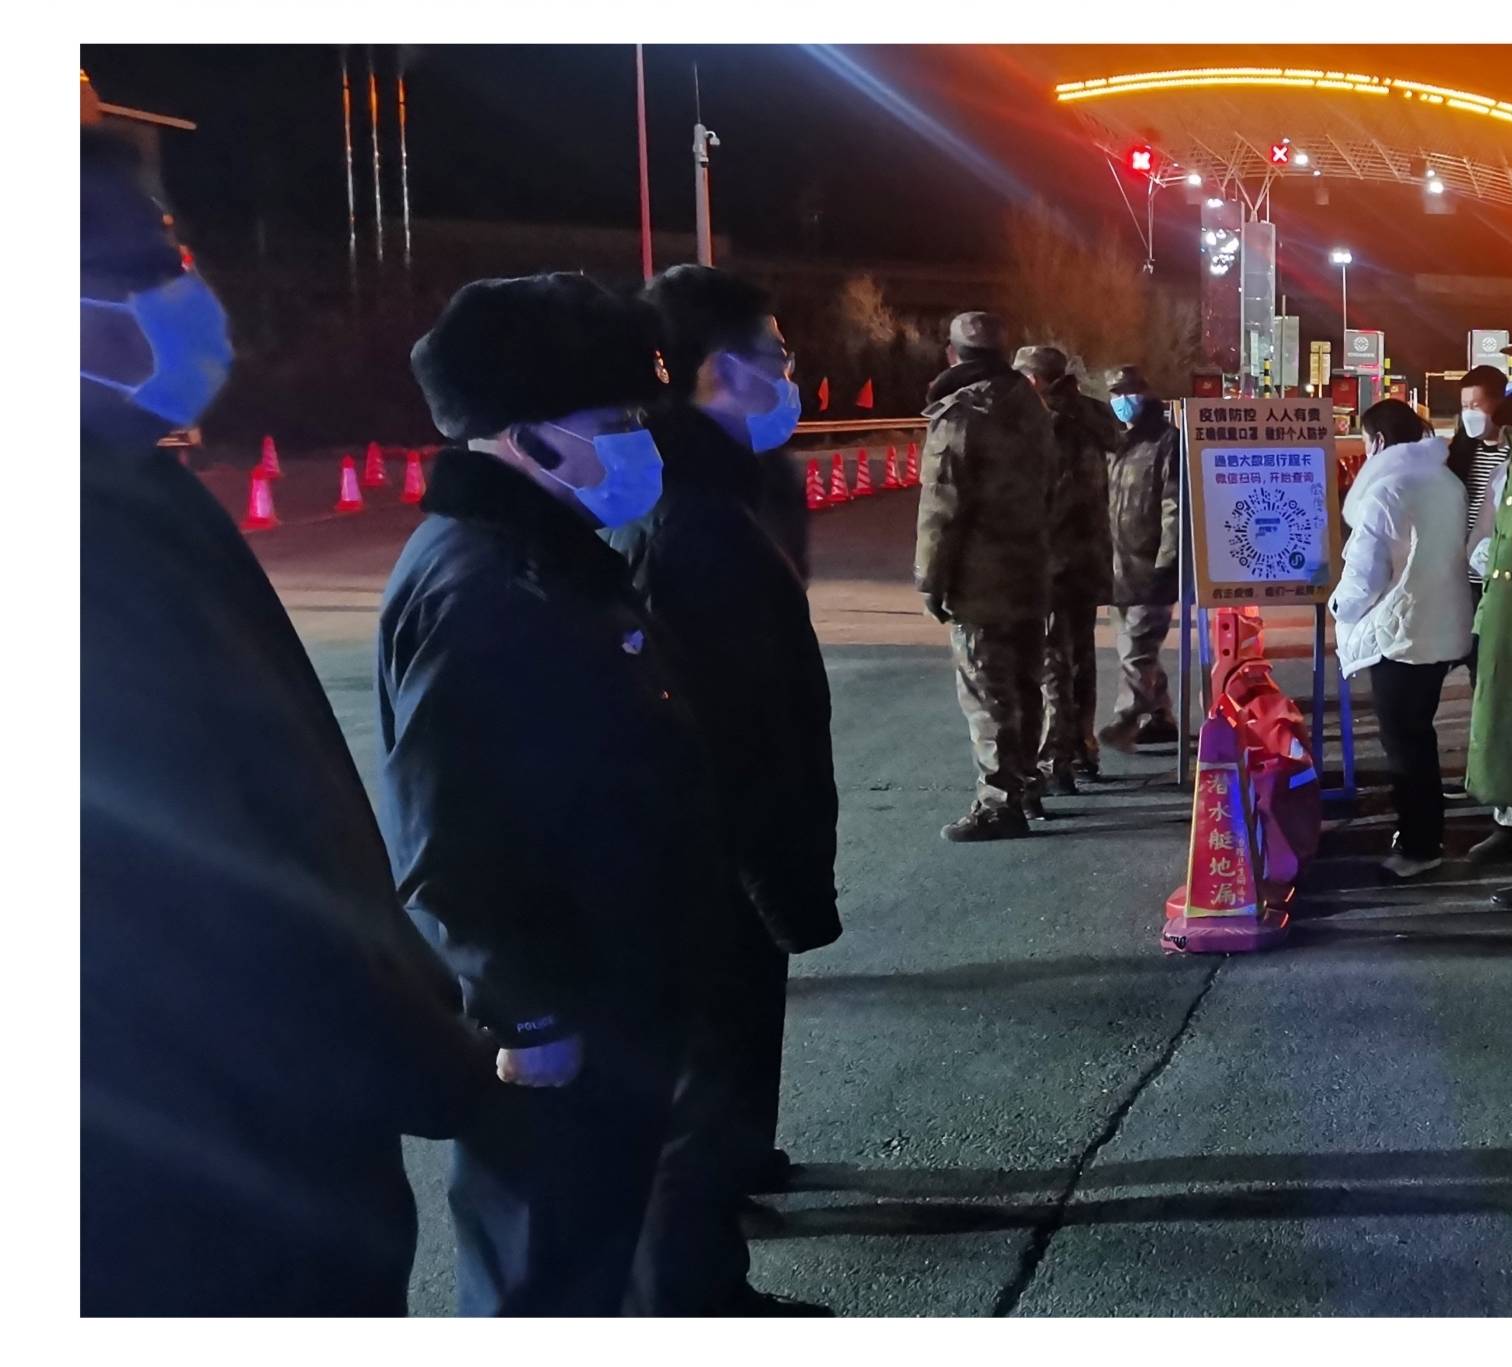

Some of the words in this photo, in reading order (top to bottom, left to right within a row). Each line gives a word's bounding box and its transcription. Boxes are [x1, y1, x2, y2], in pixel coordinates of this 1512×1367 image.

[1200, 408, 1257, 422] 疫情防控
[1266, 408, 1321, 422] 人人有责
[1195, 427, 1258, 441] 正确佩戴口罩
[1265, 427, 1328, 441] 做好个人防护
[1214, 454, 1312, 467] 通信大数据行程卡
[1206, 773, 1236, 906] 潜水艇地漏
[516, 1016, 555, 1032] POL
